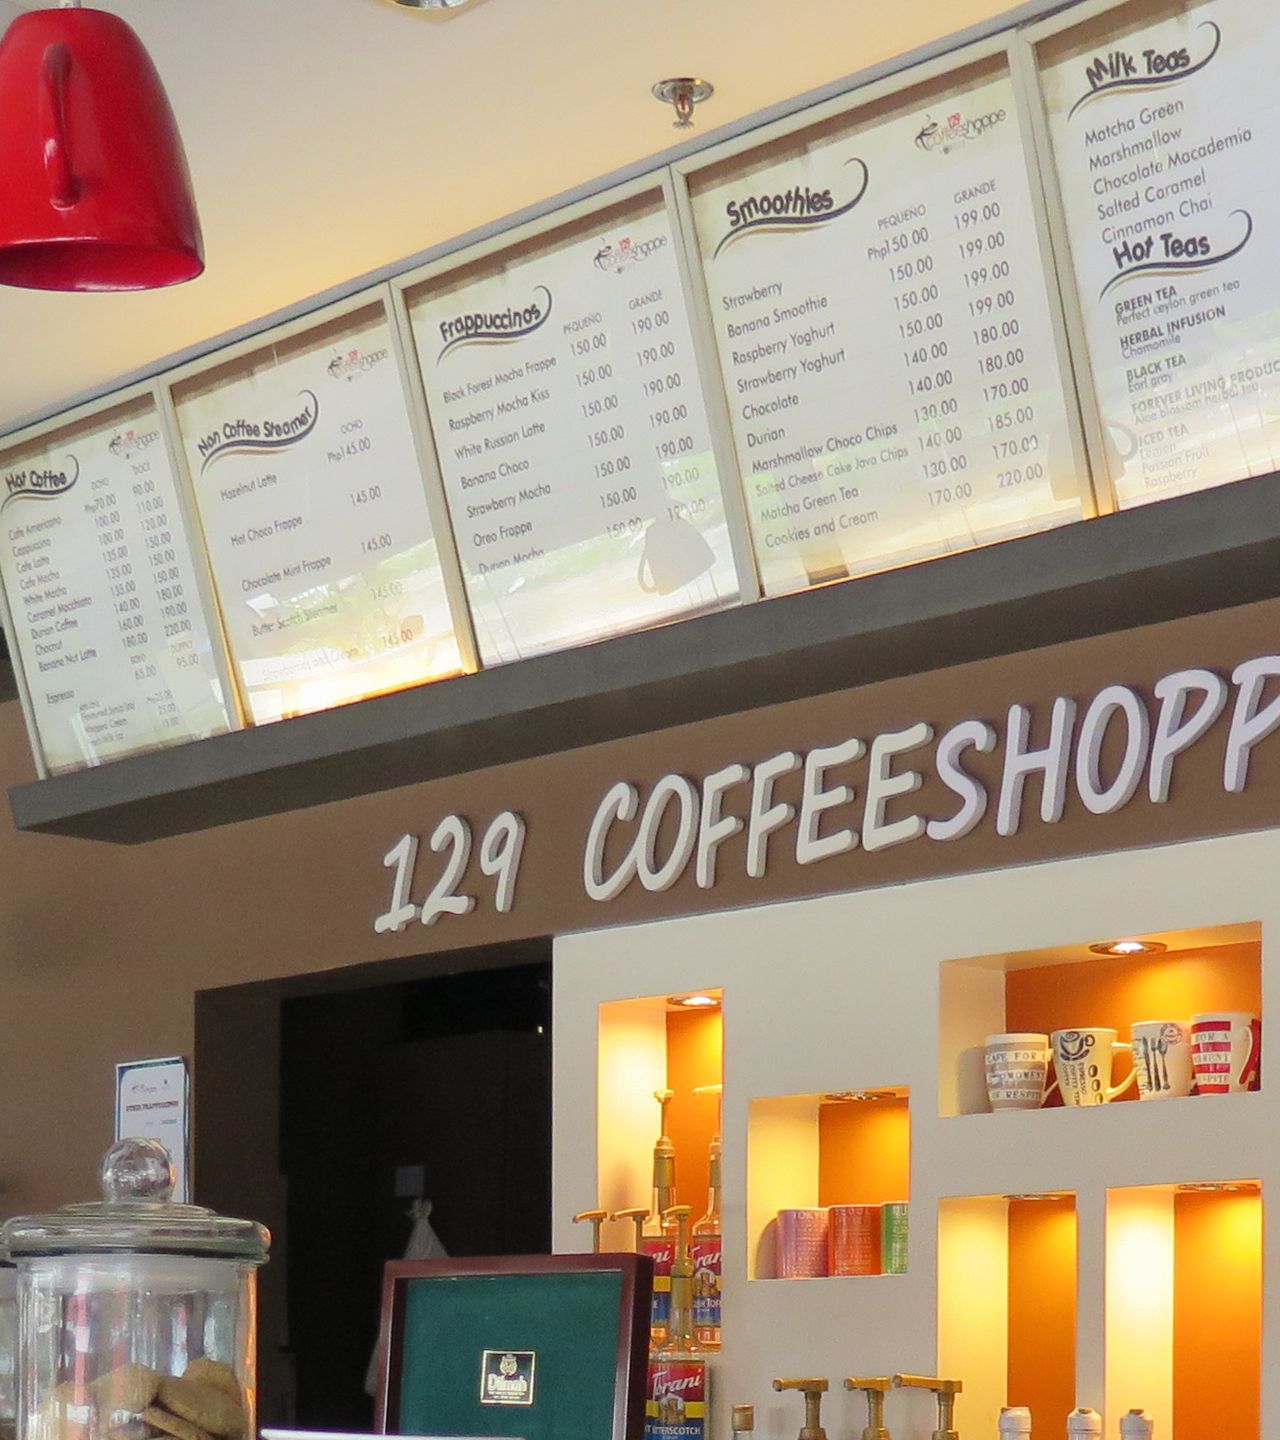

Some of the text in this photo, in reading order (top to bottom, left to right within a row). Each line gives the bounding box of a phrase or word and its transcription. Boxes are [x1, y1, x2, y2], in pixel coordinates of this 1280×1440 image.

[1086, 46, 1191, 89] Milk Teas
[1084, 100, 1184, 146] Matcha Green
[1089, 127, 1181, 171] Marshmallow
[1093, 127, 1251, 195] Chocolate Macademia
[726, 186, 835, 228] Smoothies
[953, 179, 996, 204] GRANDE
[1096, 167, 1206, 220] Salted Caramel
[954, 201, 1000, 229] 199.00
[1101, 192, 1212, 244] Cinnamon Chai
[888, 231, 1005, 281] 150.00 199.00
[1113, 232, 1212, 270] Hot Teas
[722, 282, 782, 310] Strawberry
[893, 283, 938, 310] 150.00
[1114, 285, 1176, 317] GREEN TEA
[1115, 305, 1150, 326] Perfect
[1188, 286, 1219, 306] green
[1222, 279, 1240, 291] tea
[439, 304, 542, 342] Frappuccinos
[570, 310, 669, 356] 150.00 190.00
[726, 296, 827, 338] Banana Smoothie
[1119, 304, 1225, 349] HERBAL INFUSION
[731, 321, 834, 366] Raspberry Yoghurt
[903, 319, 1019, 366] 140.00 180.00
[1121, 332, 1181, 359] Chamomile
[442, 356, 556, 403] Black Forest Mocha Frappe
[575, 340, 674, 387] 150.00 190.00
[736, 348, 845, 393] Strawberry Yoghurt
[908, 369, 952, 394] 140.00
[1125, 353, 1186, 383] BLACK TEA
[448, 388, 550, 431] Raspberry Mocha Kiss
[741, 393, 799, 420] Chocolate
[913, 376, 1028, 423] 130.00 170.00
[1131, 389, 1182, 414] FOREVER
[1184, 375, 1225, 399] LIVING
[197, 405, 314, 458] Non Coffee Steamer
[746, 428, 785, 447] Durian
[987, 405, 1033, 431] 185.00
[1138, 422, 1189, 447] ICED TEA
[453, 422, 545, 459] White Russian Latte
[752, 423, 897, 473] Marshmallow Choco Chips
[922, 433, 1038, 478] 130.00 170.00
[5, 471, 67, 493] Hot Coffee
[255, 473, 276, 488] Latte
[460, 459, 529, 489] Banana Choco
[787, 471, 823, 488] Cheese
[825, 462, 852, 477] Cake
[854, 456, 877, 470] Java
[879, 446, 908, 463] Chips
[996, 462, 1043, 488] 220.00
[466, 483, 551, 518] Strawberry Mocha
[760, 486, 859, 521] Matcha Green Tea
[230, 516, 302, 545] Hot Choco Frappe
[764, 510, 879, 548] Cookies and Cream
[374, 811, 526, 934] 129
[652, 1369, 703, 1400] Torani
